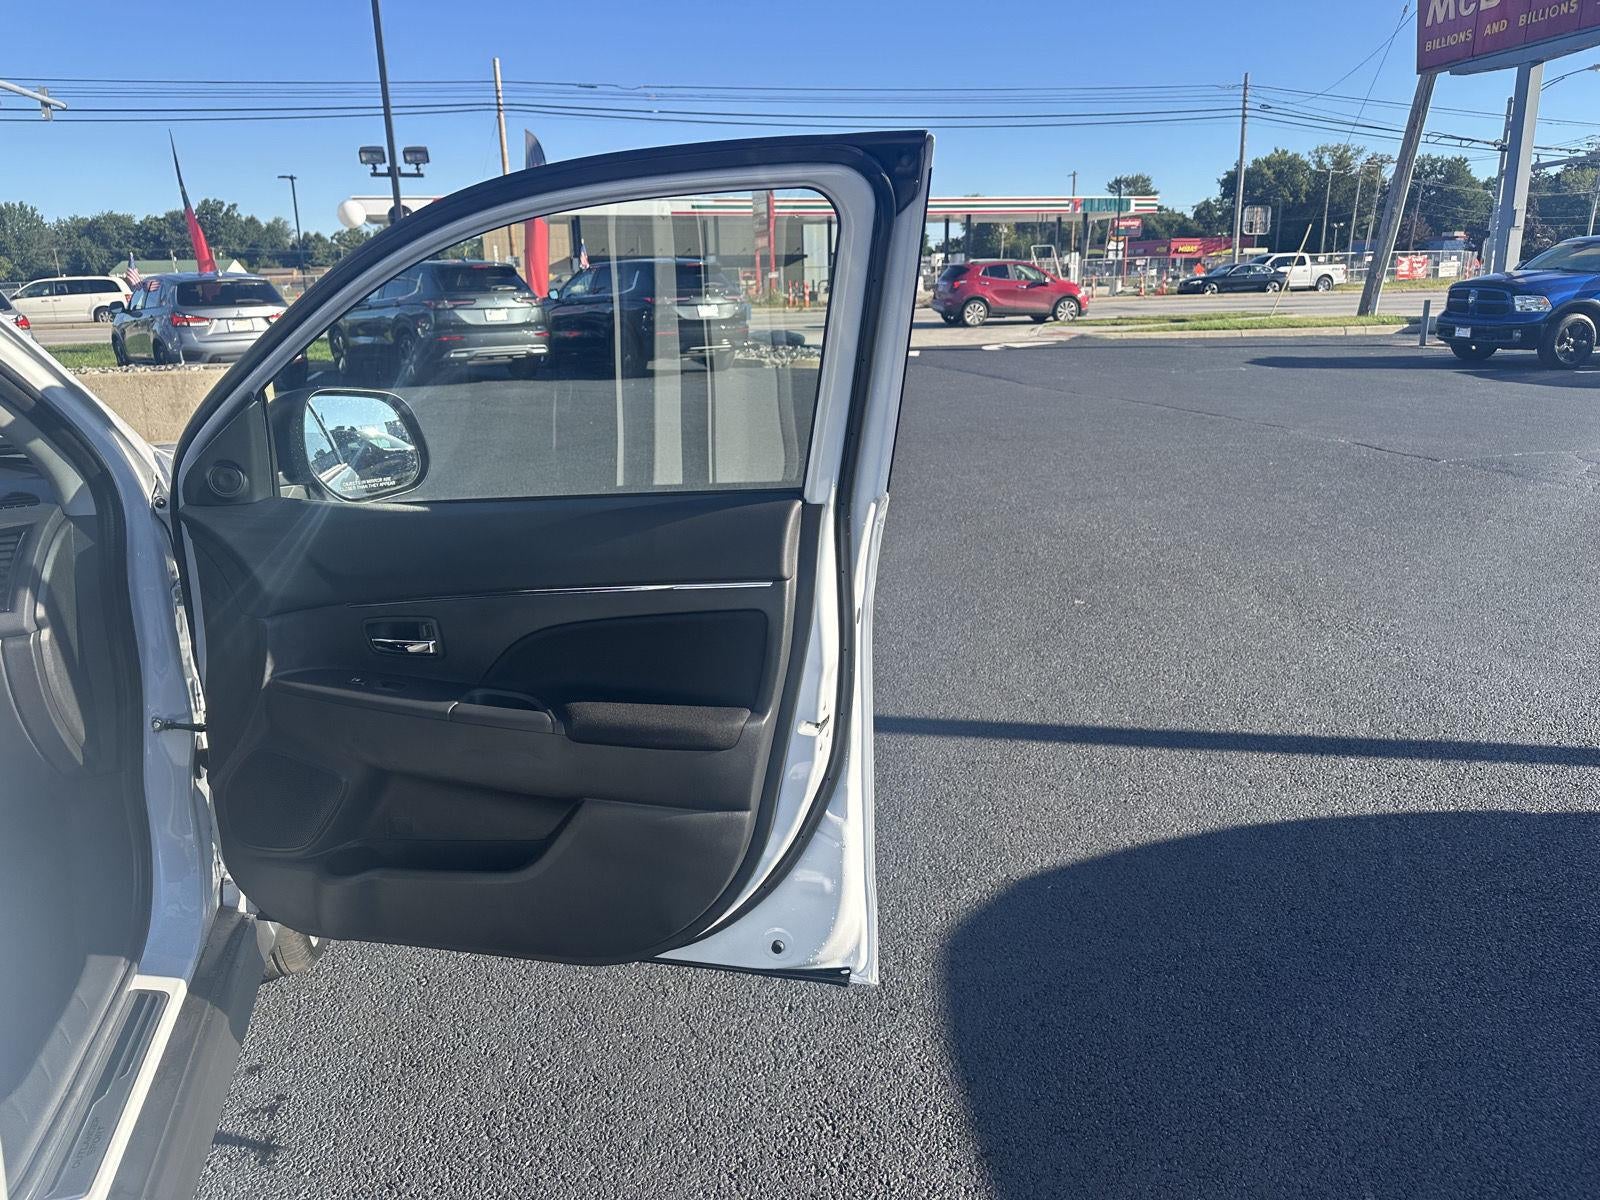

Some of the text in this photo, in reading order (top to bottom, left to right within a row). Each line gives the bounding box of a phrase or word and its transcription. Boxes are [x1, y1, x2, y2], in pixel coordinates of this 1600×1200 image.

[1425, 0, 1579, 52] BILLIONS AND BILLIONS
